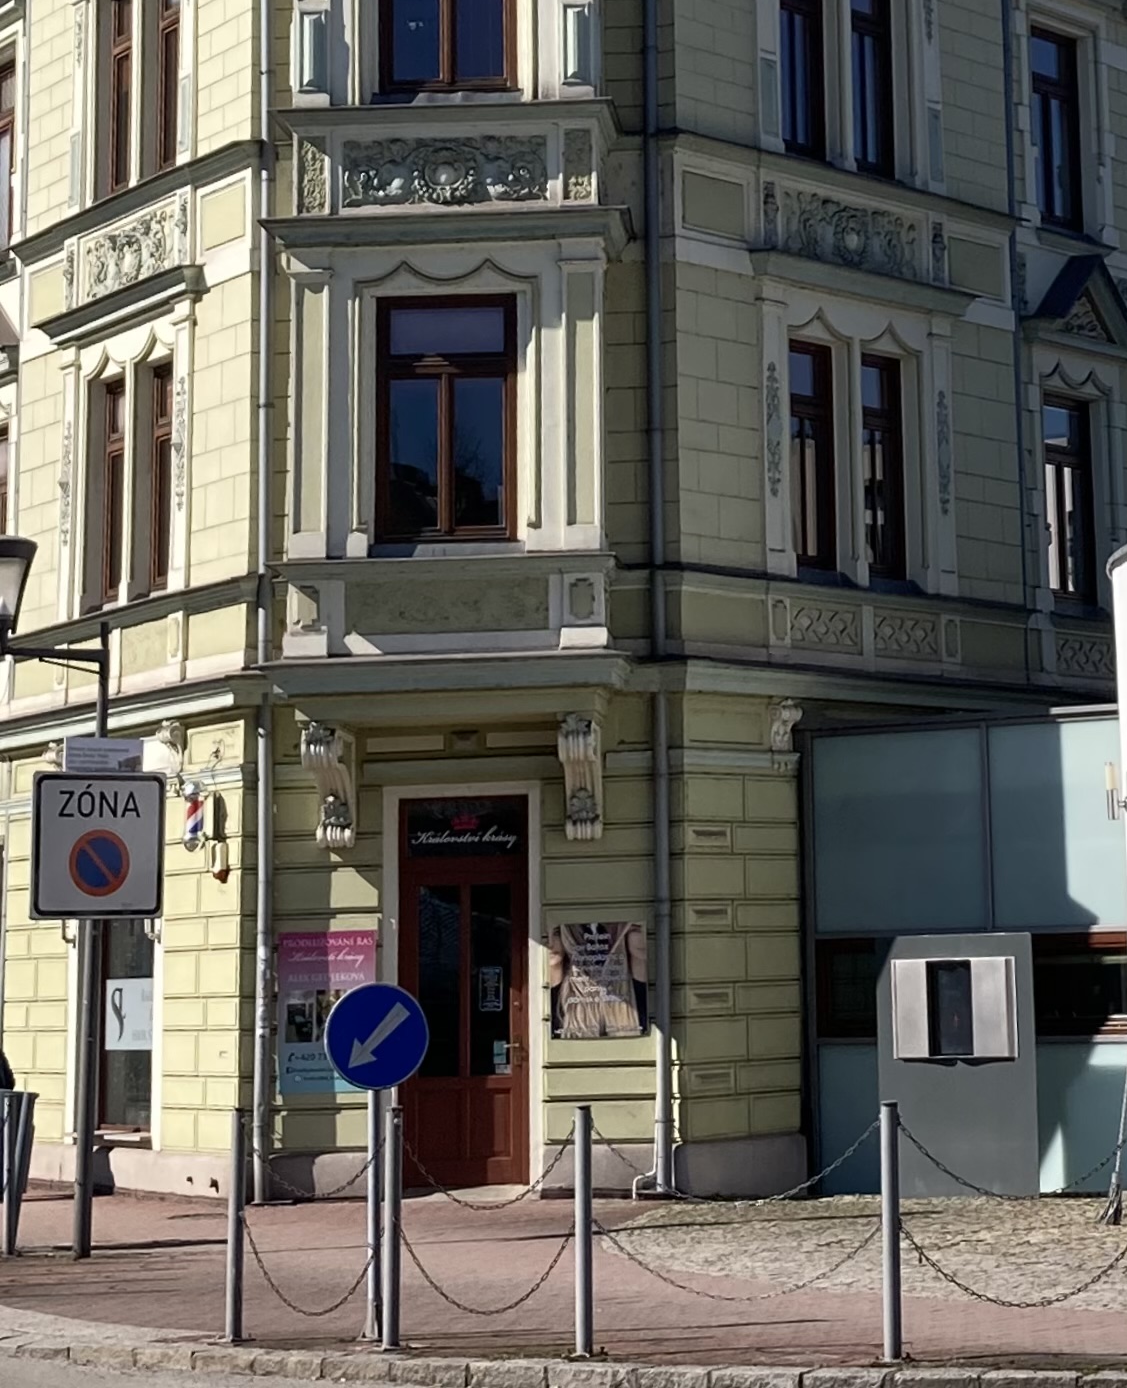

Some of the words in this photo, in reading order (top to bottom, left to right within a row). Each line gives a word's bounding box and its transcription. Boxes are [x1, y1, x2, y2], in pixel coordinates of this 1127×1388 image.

[58, 783, 141, 818] ZÓNA
[411, 830, 481, 844] Království
[481, 825, 517, 849] krásy
